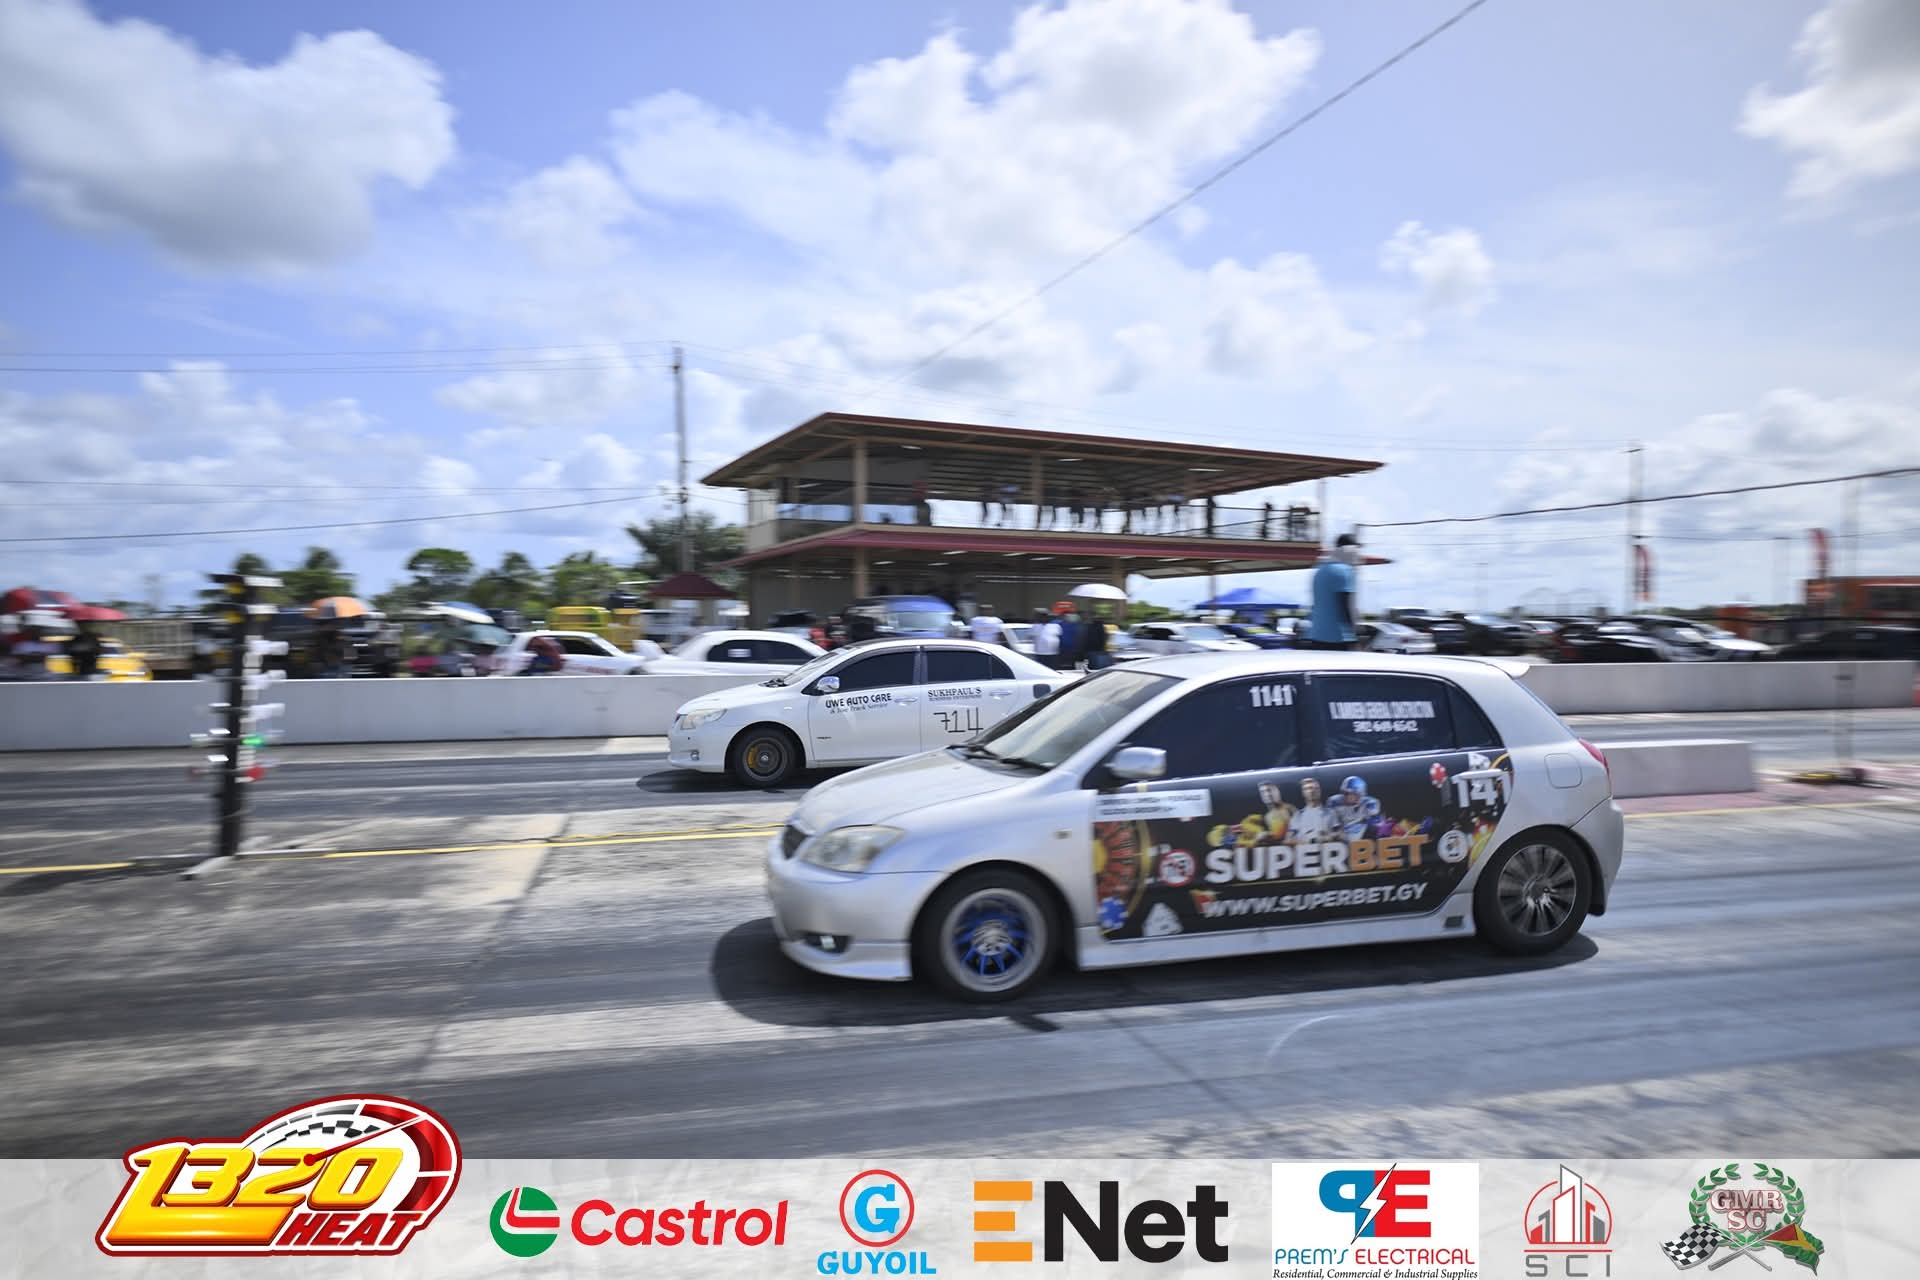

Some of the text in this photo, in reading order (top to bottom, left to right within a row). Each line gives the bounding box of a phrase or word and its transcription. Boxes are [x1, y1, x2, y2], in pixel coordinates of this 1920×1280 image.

[825, 692, 892, 709] UWE AUTO CARE
[1250, 684, 1293, 707] 1141
[933, 706, 984, 736] 714
[1204, 833, 1430, 884] SUPERBET
[1204, 882, 1429, 919] WWW.SUPERBET.GY
